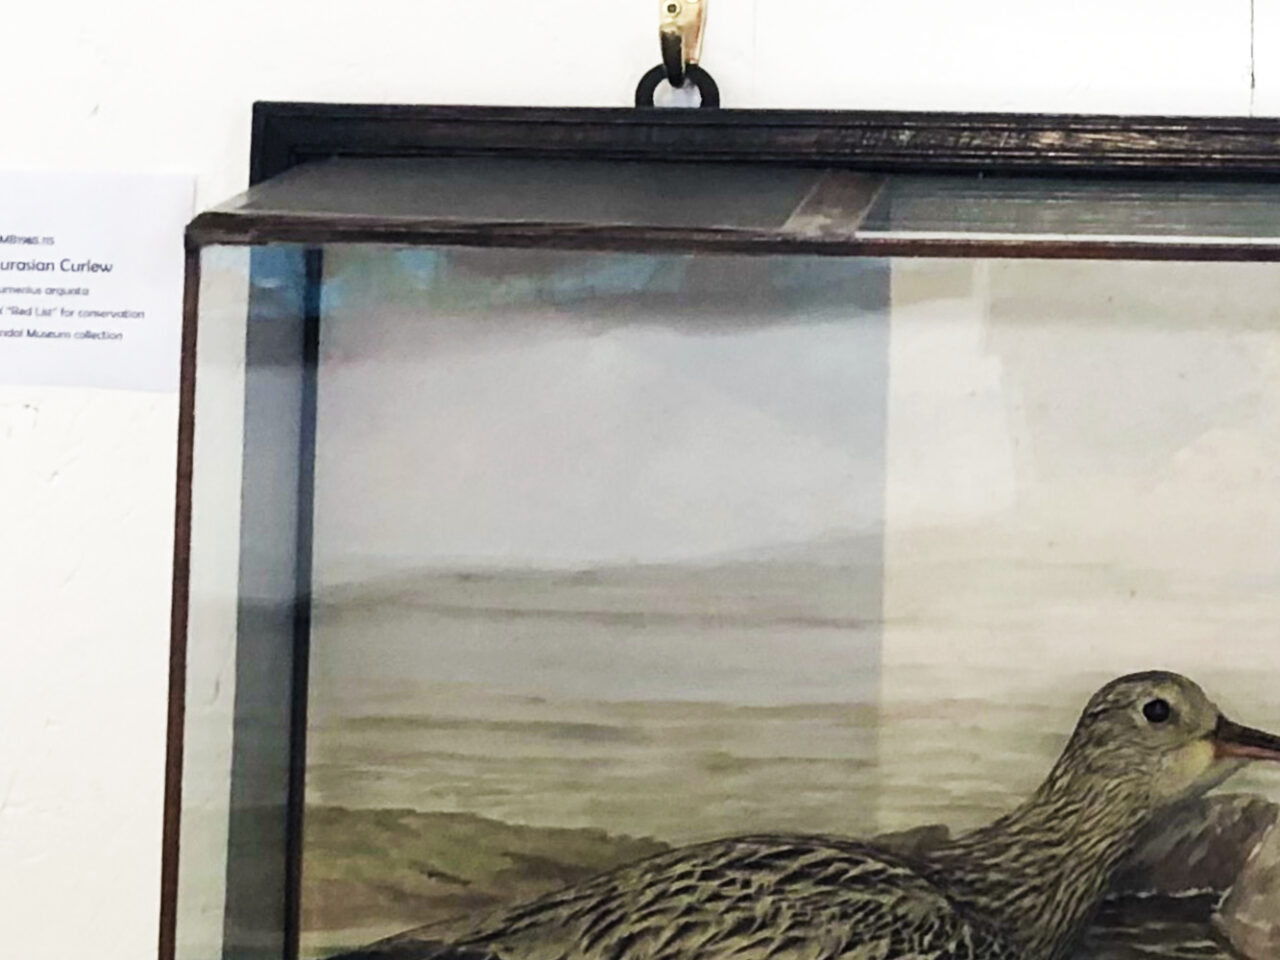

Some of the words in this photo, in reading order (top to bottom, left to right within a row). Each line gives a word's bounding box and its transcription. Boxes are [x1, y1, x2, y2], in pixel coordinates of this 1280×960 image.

[0, 259, 55, 272] urasian
[60, 258, 113, 273] Curlew
[60, 307, 75, 318] for
[78, 308, 145, 320] conservation
[26, 328, 71, 339] Museum
[74, 329, 123, 341] collection
